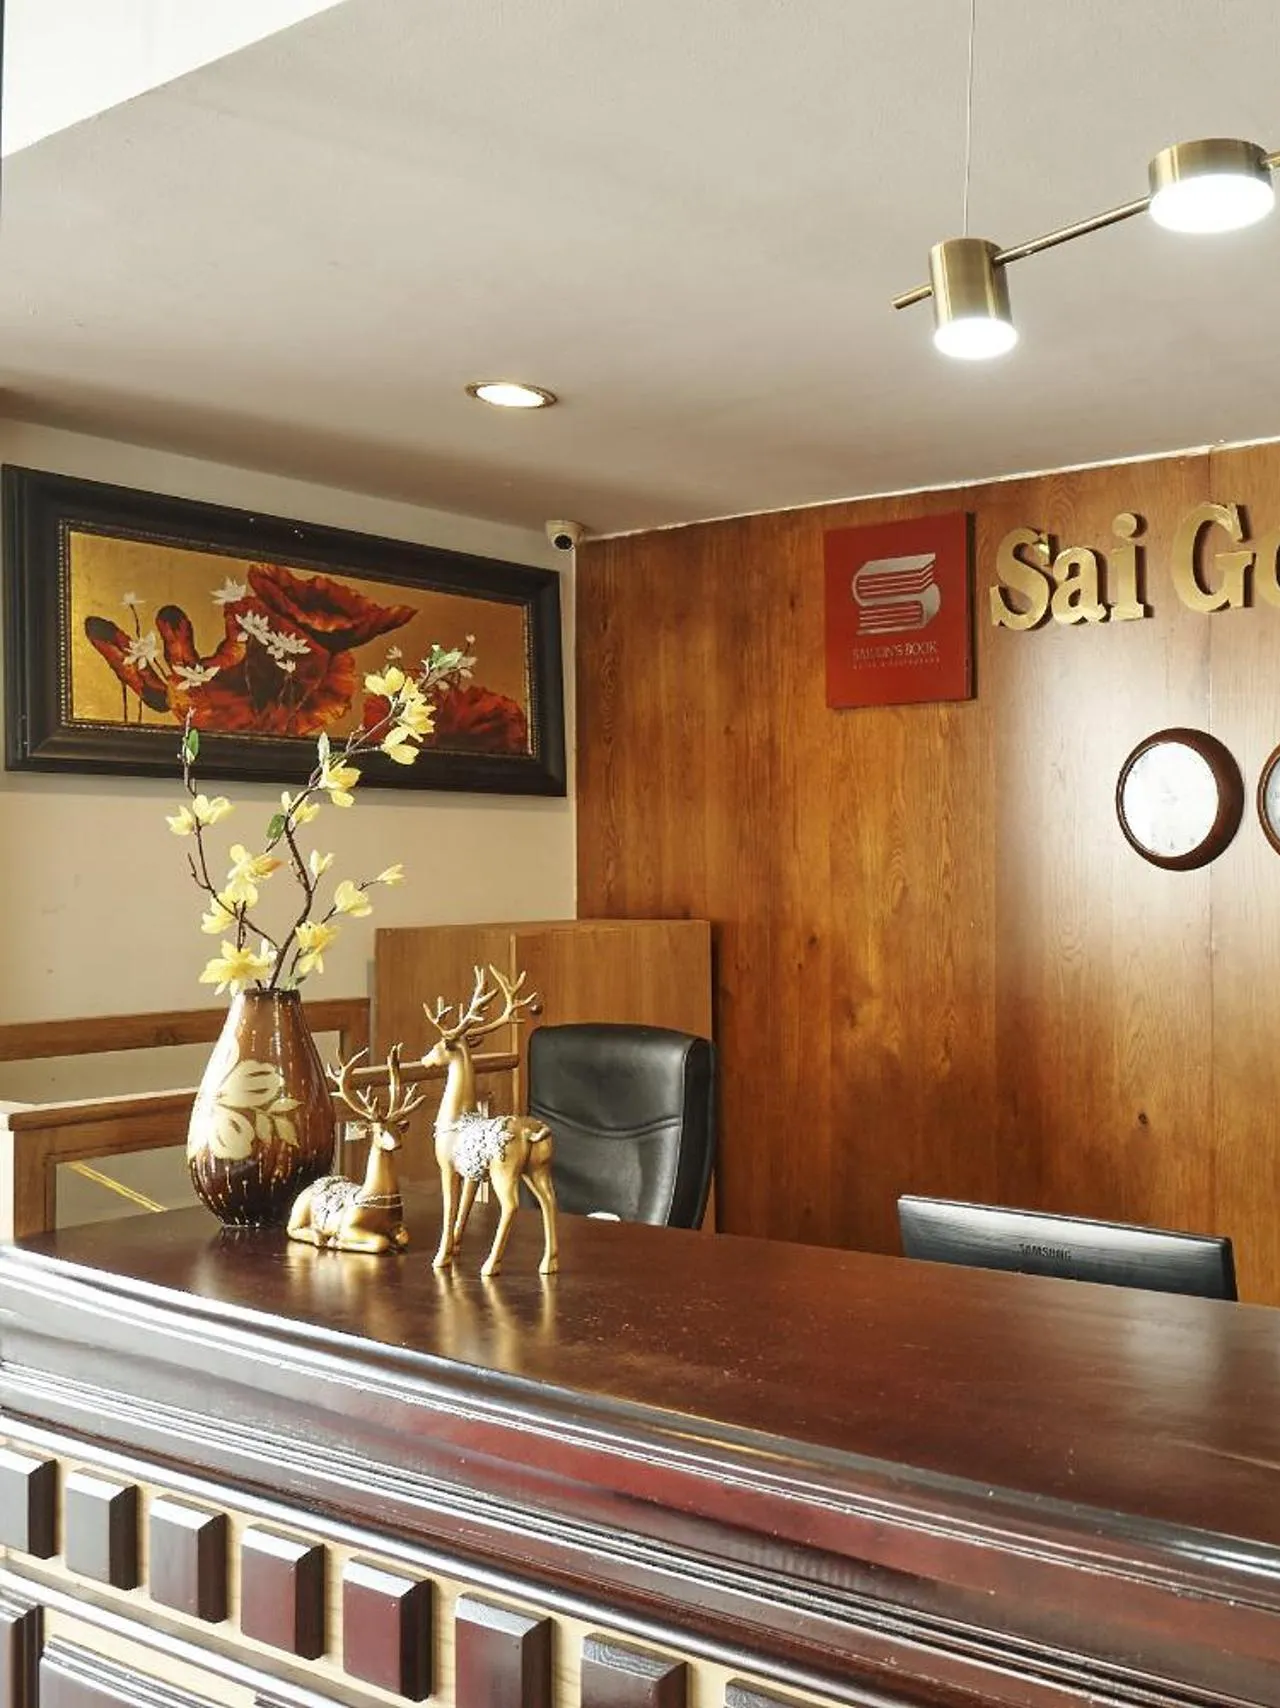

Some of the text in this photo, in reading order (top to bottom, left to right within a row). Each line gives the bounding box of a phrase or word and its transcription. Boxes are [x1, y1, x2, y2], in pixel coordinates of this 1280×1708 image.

[988, 513, 1146, 632] Sai
[904, 640, 937, 656] BOOK
[1019, 1243, 1072, 1261] SAMSUNG
